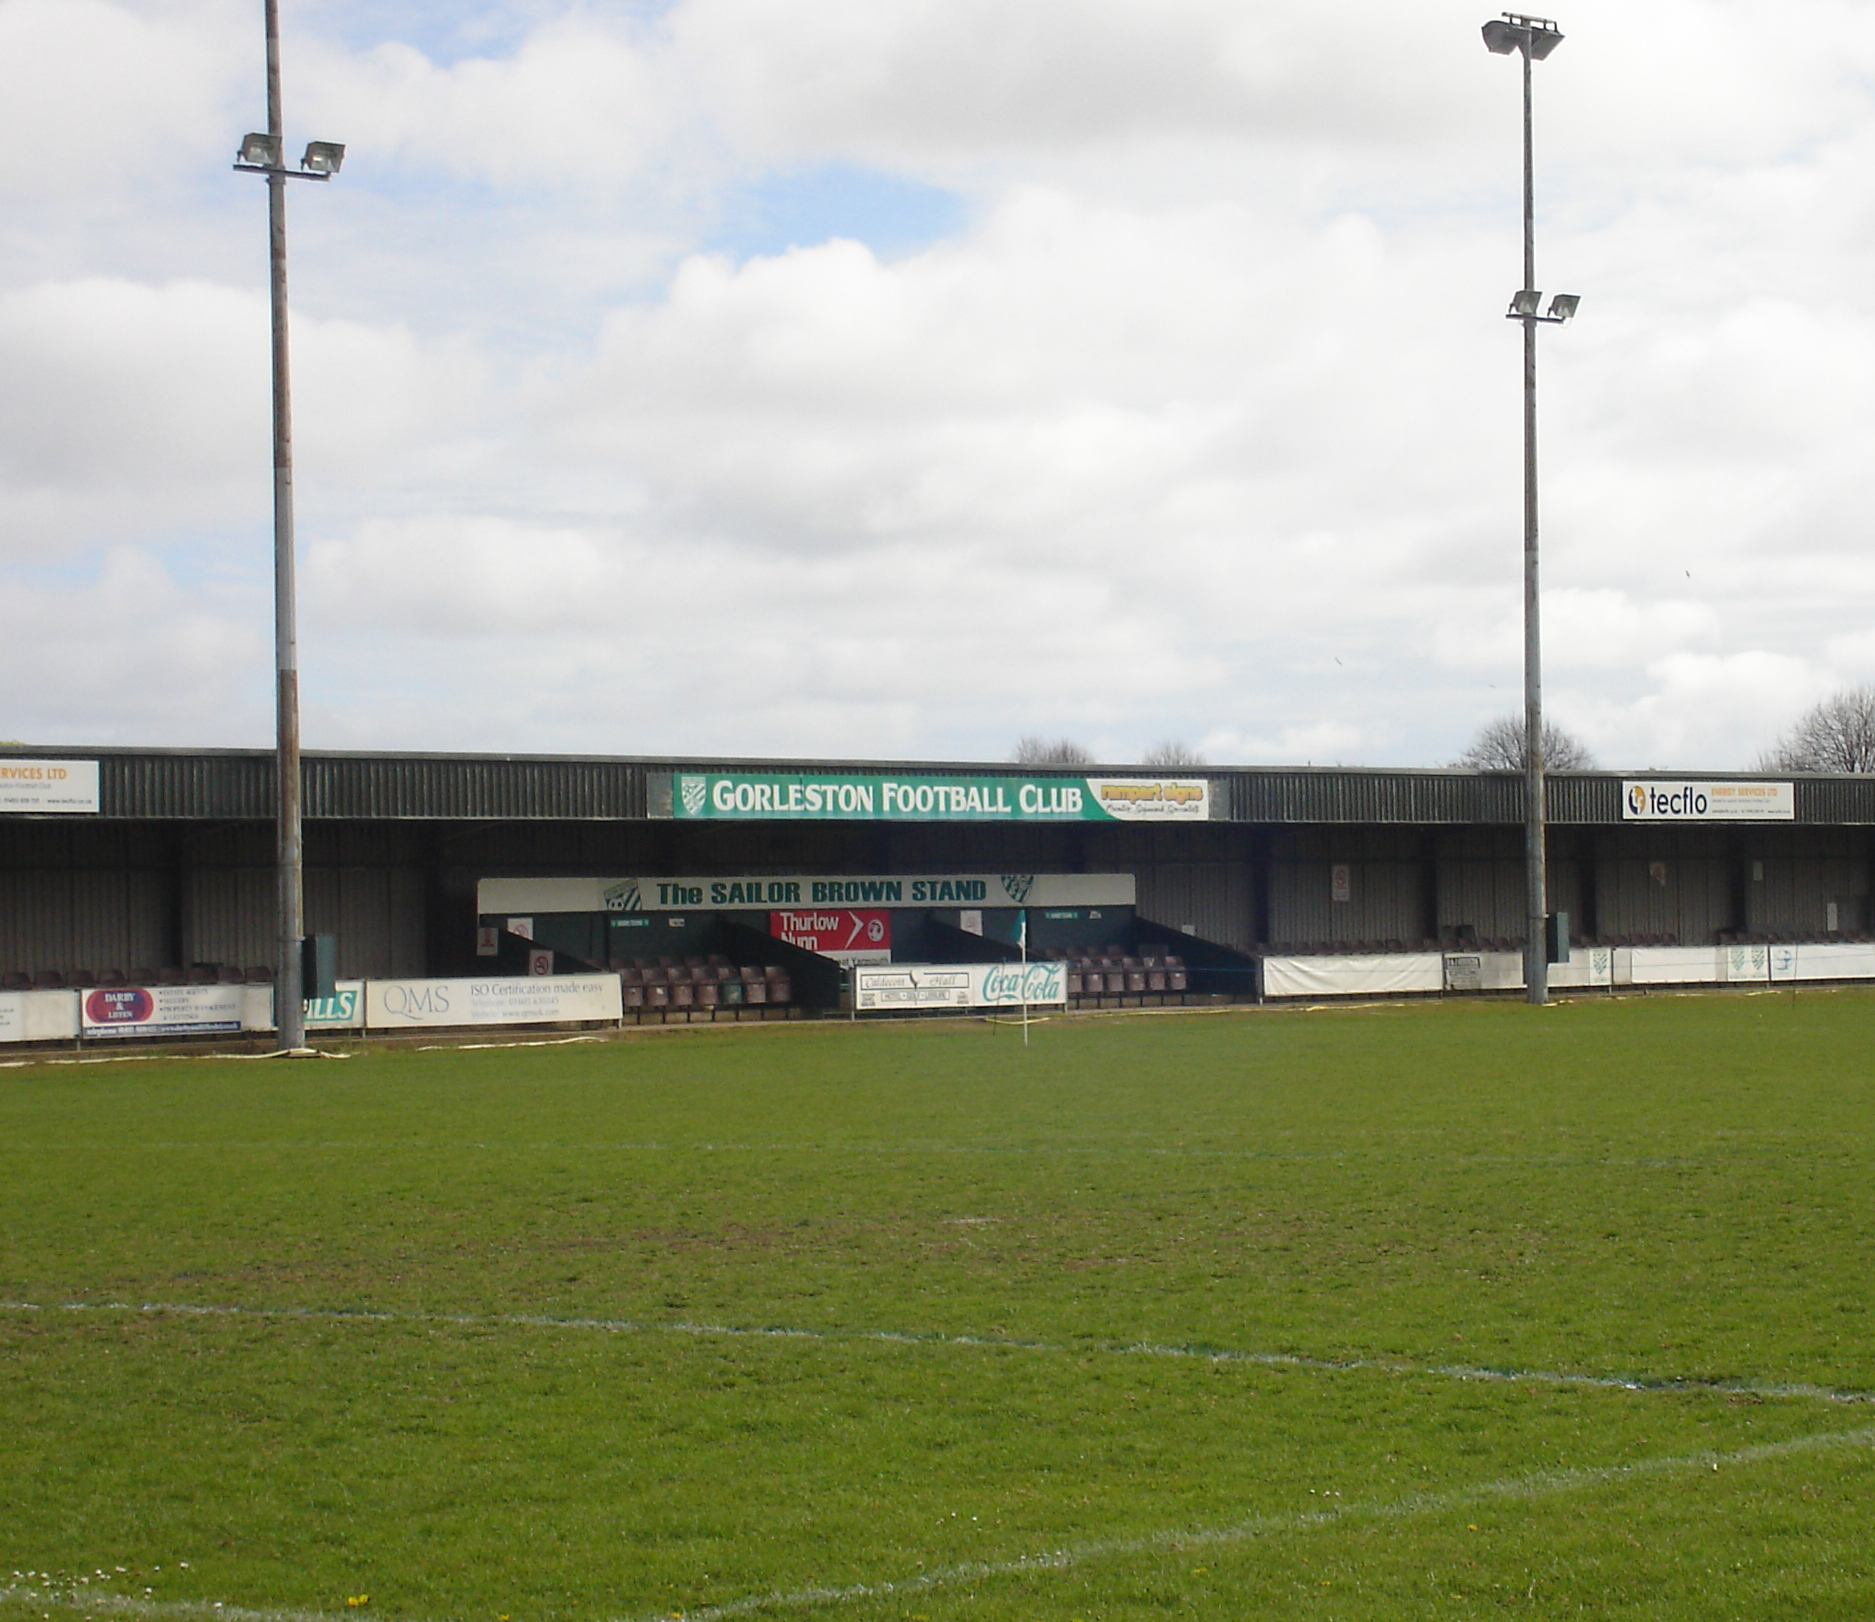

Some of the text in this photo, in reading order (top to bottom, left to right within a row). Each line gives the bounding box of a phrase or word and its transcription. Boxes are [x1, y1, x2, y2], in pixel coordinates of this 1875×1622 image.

[47, 768, 67, 780] LTD
[712, 780, 1083, 813] GORLESTON FOOTBALL CLUB
[1650, 786, 1707, 815] tecflo
[657, 883, 703, 905] The
[711, 881, 801, 905] SAILOR
[811, 880, 902, 903] BROWN
[912, 879, 986, 902] STAND
[780, 912, 839, 931] Thurlow
[471, 981, 604, 996] ISO Certification made easy
[982, 964, 1061, 1003] Coca-Cola
[105, 992, 136, 1002] DARBY
[115, 1002, 124, 1011] &
[383, 985, 450, 1021] QMS
